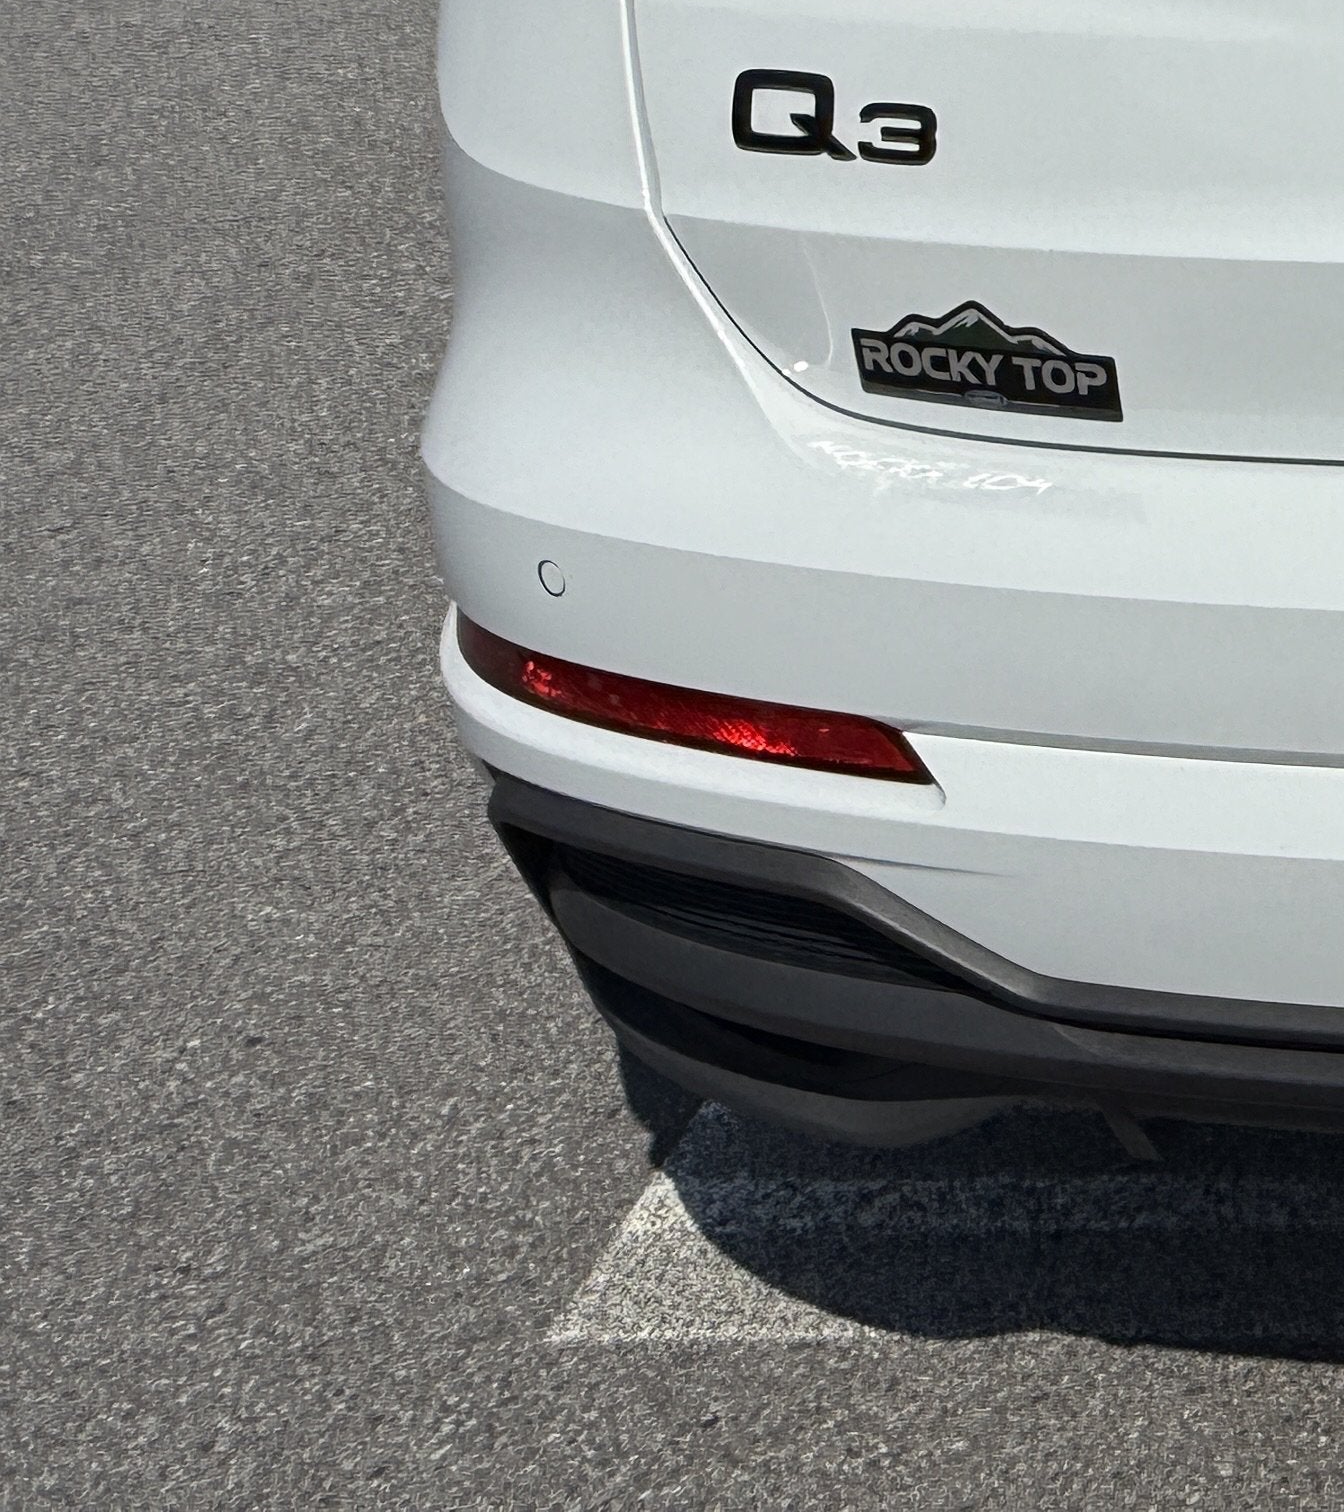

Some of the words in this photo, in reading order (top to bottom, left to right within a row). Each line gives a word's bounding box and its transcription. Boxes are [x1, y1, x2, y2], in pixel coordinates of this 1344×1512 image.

[731, 67, 938, 166] Q3
[859, 337, 1004, 387] ROCKY
[1011, 355, 1108, 396] TOP
